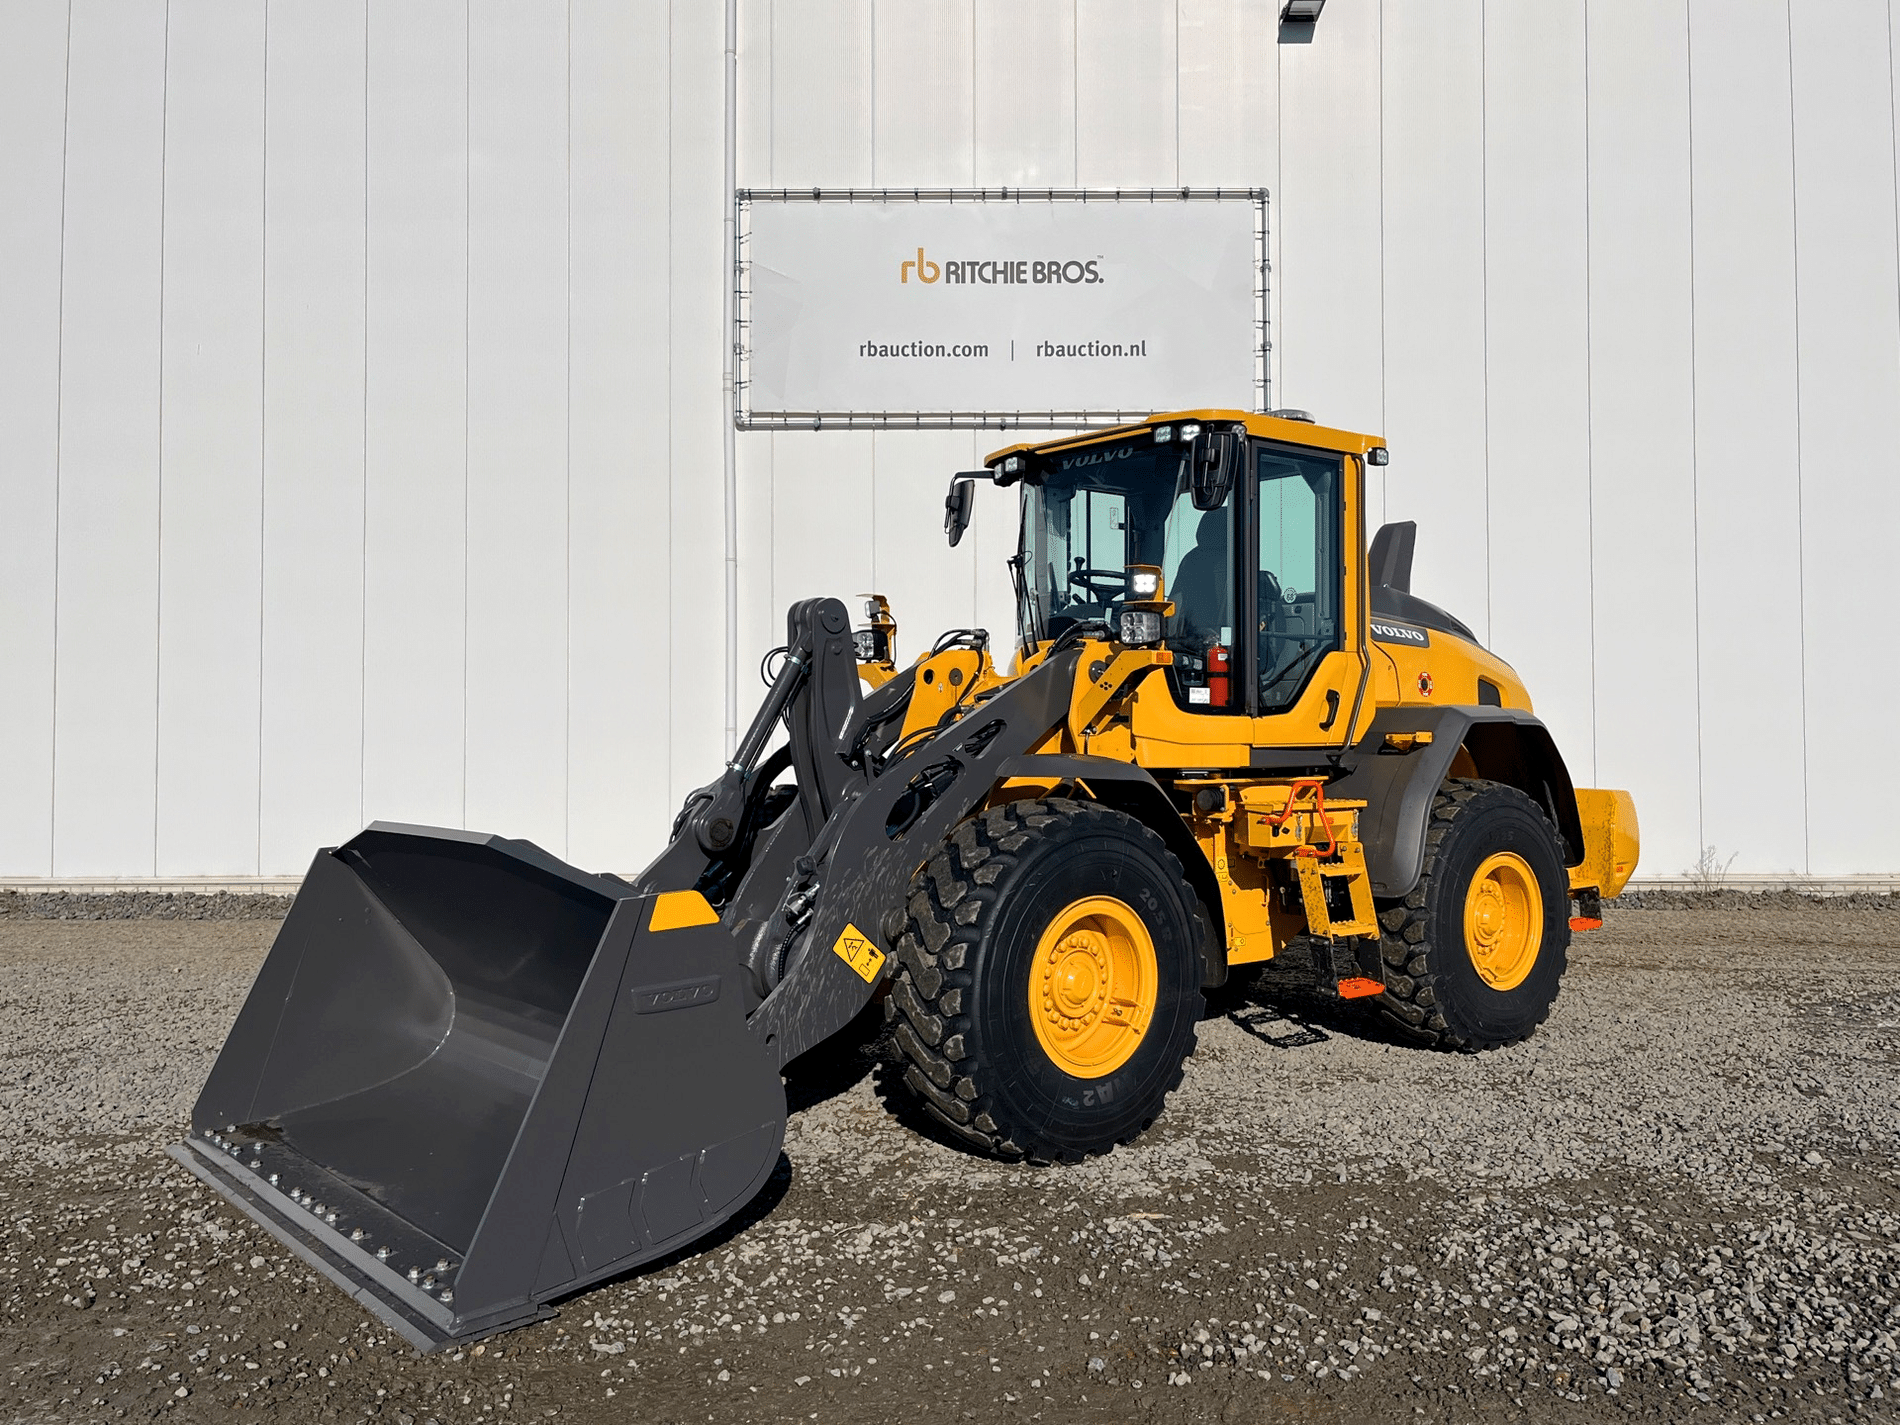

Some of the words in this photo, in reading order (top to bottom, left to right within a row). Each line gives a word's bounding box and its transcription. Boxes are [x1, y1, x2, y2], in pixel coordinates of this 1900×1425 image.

[901, 247, 940, 284] rb
[945, 261, 1028, 284] RITCHIE
[1032, 260, 1104, 284] BROS.
[859, 340, 989, 357] rbauction.com
[1036, 340, 1147, 357] rbauction.nl
[1062, 447, 1133, 470] VOLVO
[1370, 624, 1424, 641] VOLVO
[643, 984, 714, 1006] VOLVO
